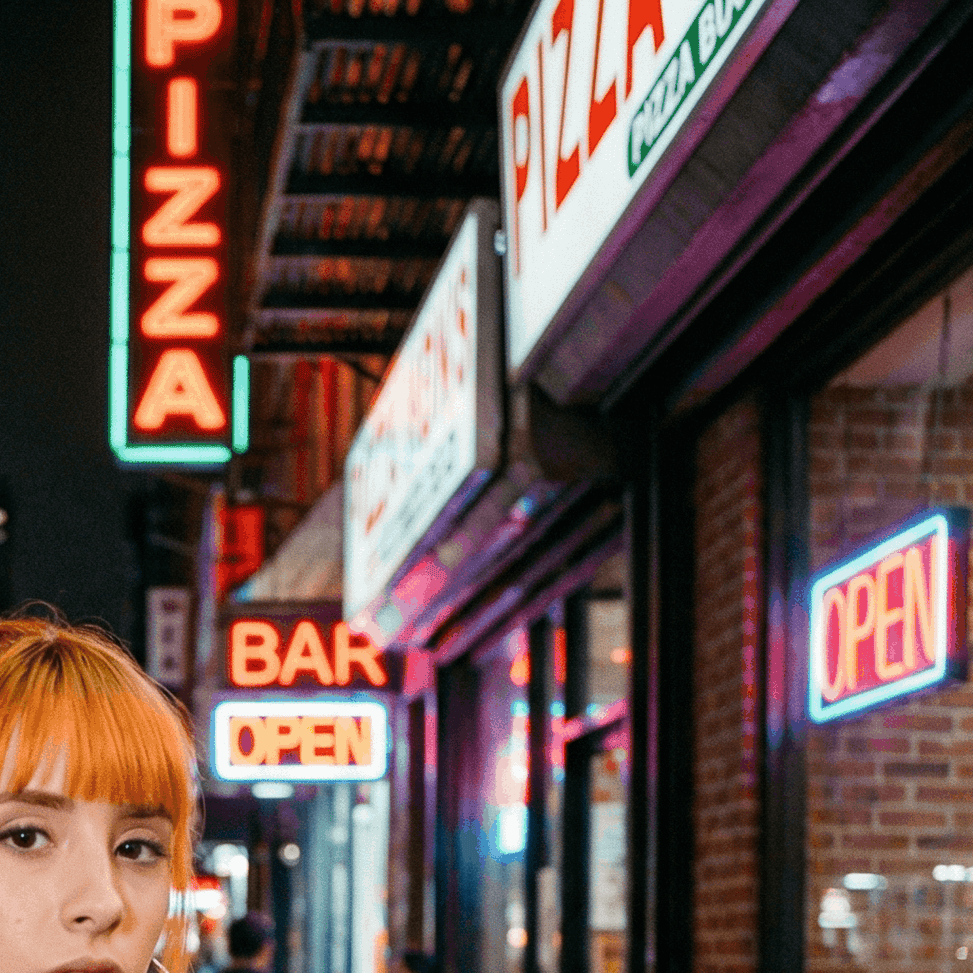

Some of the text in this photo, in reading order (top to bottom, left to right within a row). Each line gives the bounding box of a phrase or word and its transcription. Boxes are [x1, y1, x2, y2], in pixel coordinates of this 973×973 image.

[631, 39, 695, 164] PIZZA
[134, 0, 227, 429] PIZZA
[231, 619, 389, 687] BAR
[821, 534, 941, 701] OPEN
[229, 716, 372, 766] OPEN
